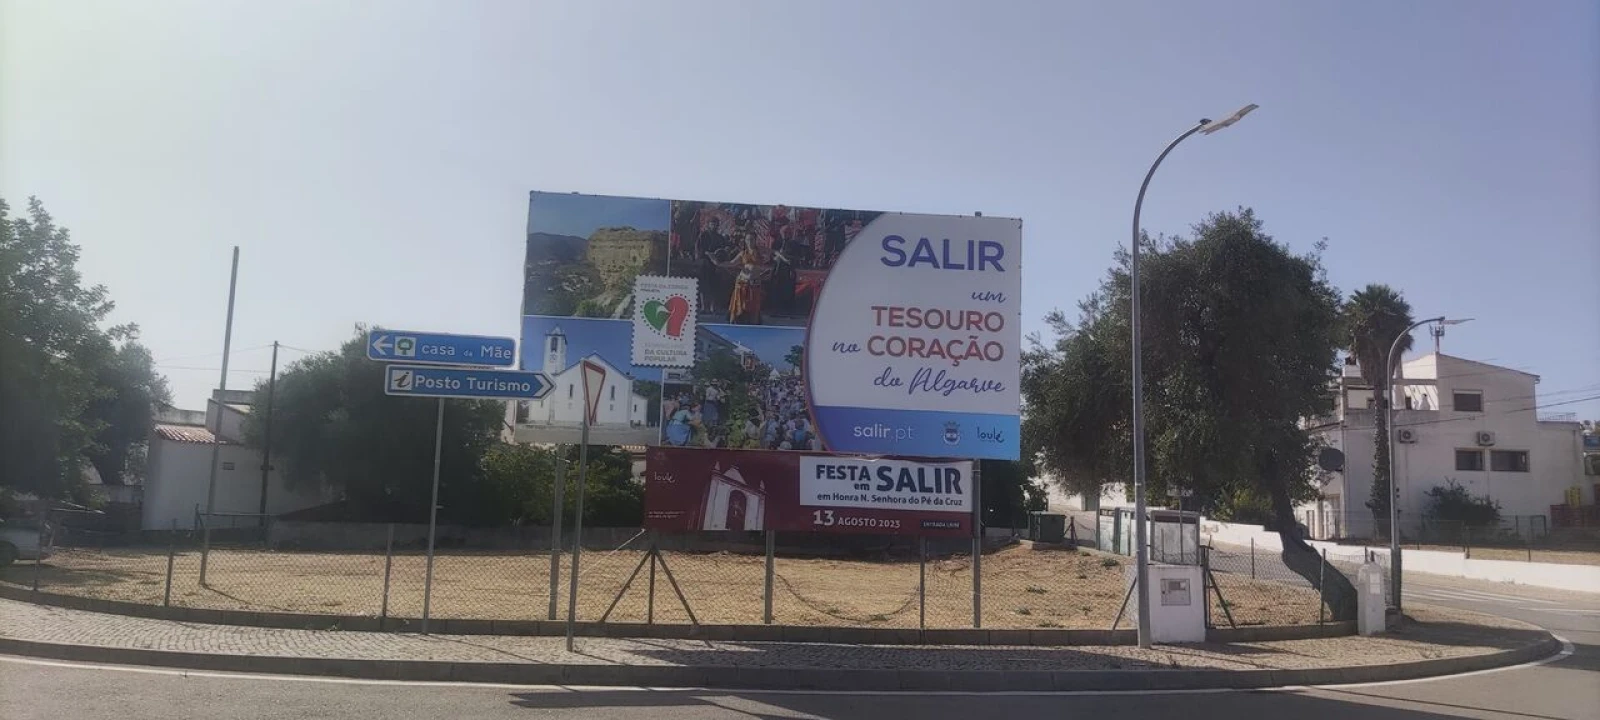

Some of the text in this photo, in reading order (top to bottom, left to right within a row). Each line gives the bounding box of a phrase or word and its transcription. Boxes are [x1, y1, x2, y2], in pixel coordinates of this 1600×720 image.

[880, 235, 1006, 272] SALIR
[971, 291, 1006, 303] um
[871, 305, 1005, 332] TESOURO
[421, 344, 456, 357] casa
[480, 345, 512, 359] Mãe
[867, 335, 1004, 366] CORAÇÃO
[415, 376, 461, 390] Posto
[466, 377, 531, 392] Turismo
[908, 367, 1006, 396] Algarve
[815, 464, 963, 495] FESTA em SALIR
[832, 492, 860, 502] Honra
[860, 494, 870, 503] N.
[871, 494, 908, 504] Senhora
[908, 495, 920, 505] do
[920, 495, 932, 505] Pé
[933, 496, 944, 506] da
[944, 496, 963, 506] Cruz
[813, 510, 835, 526] 13
[838, 516, 877, 527] AGOSTO
